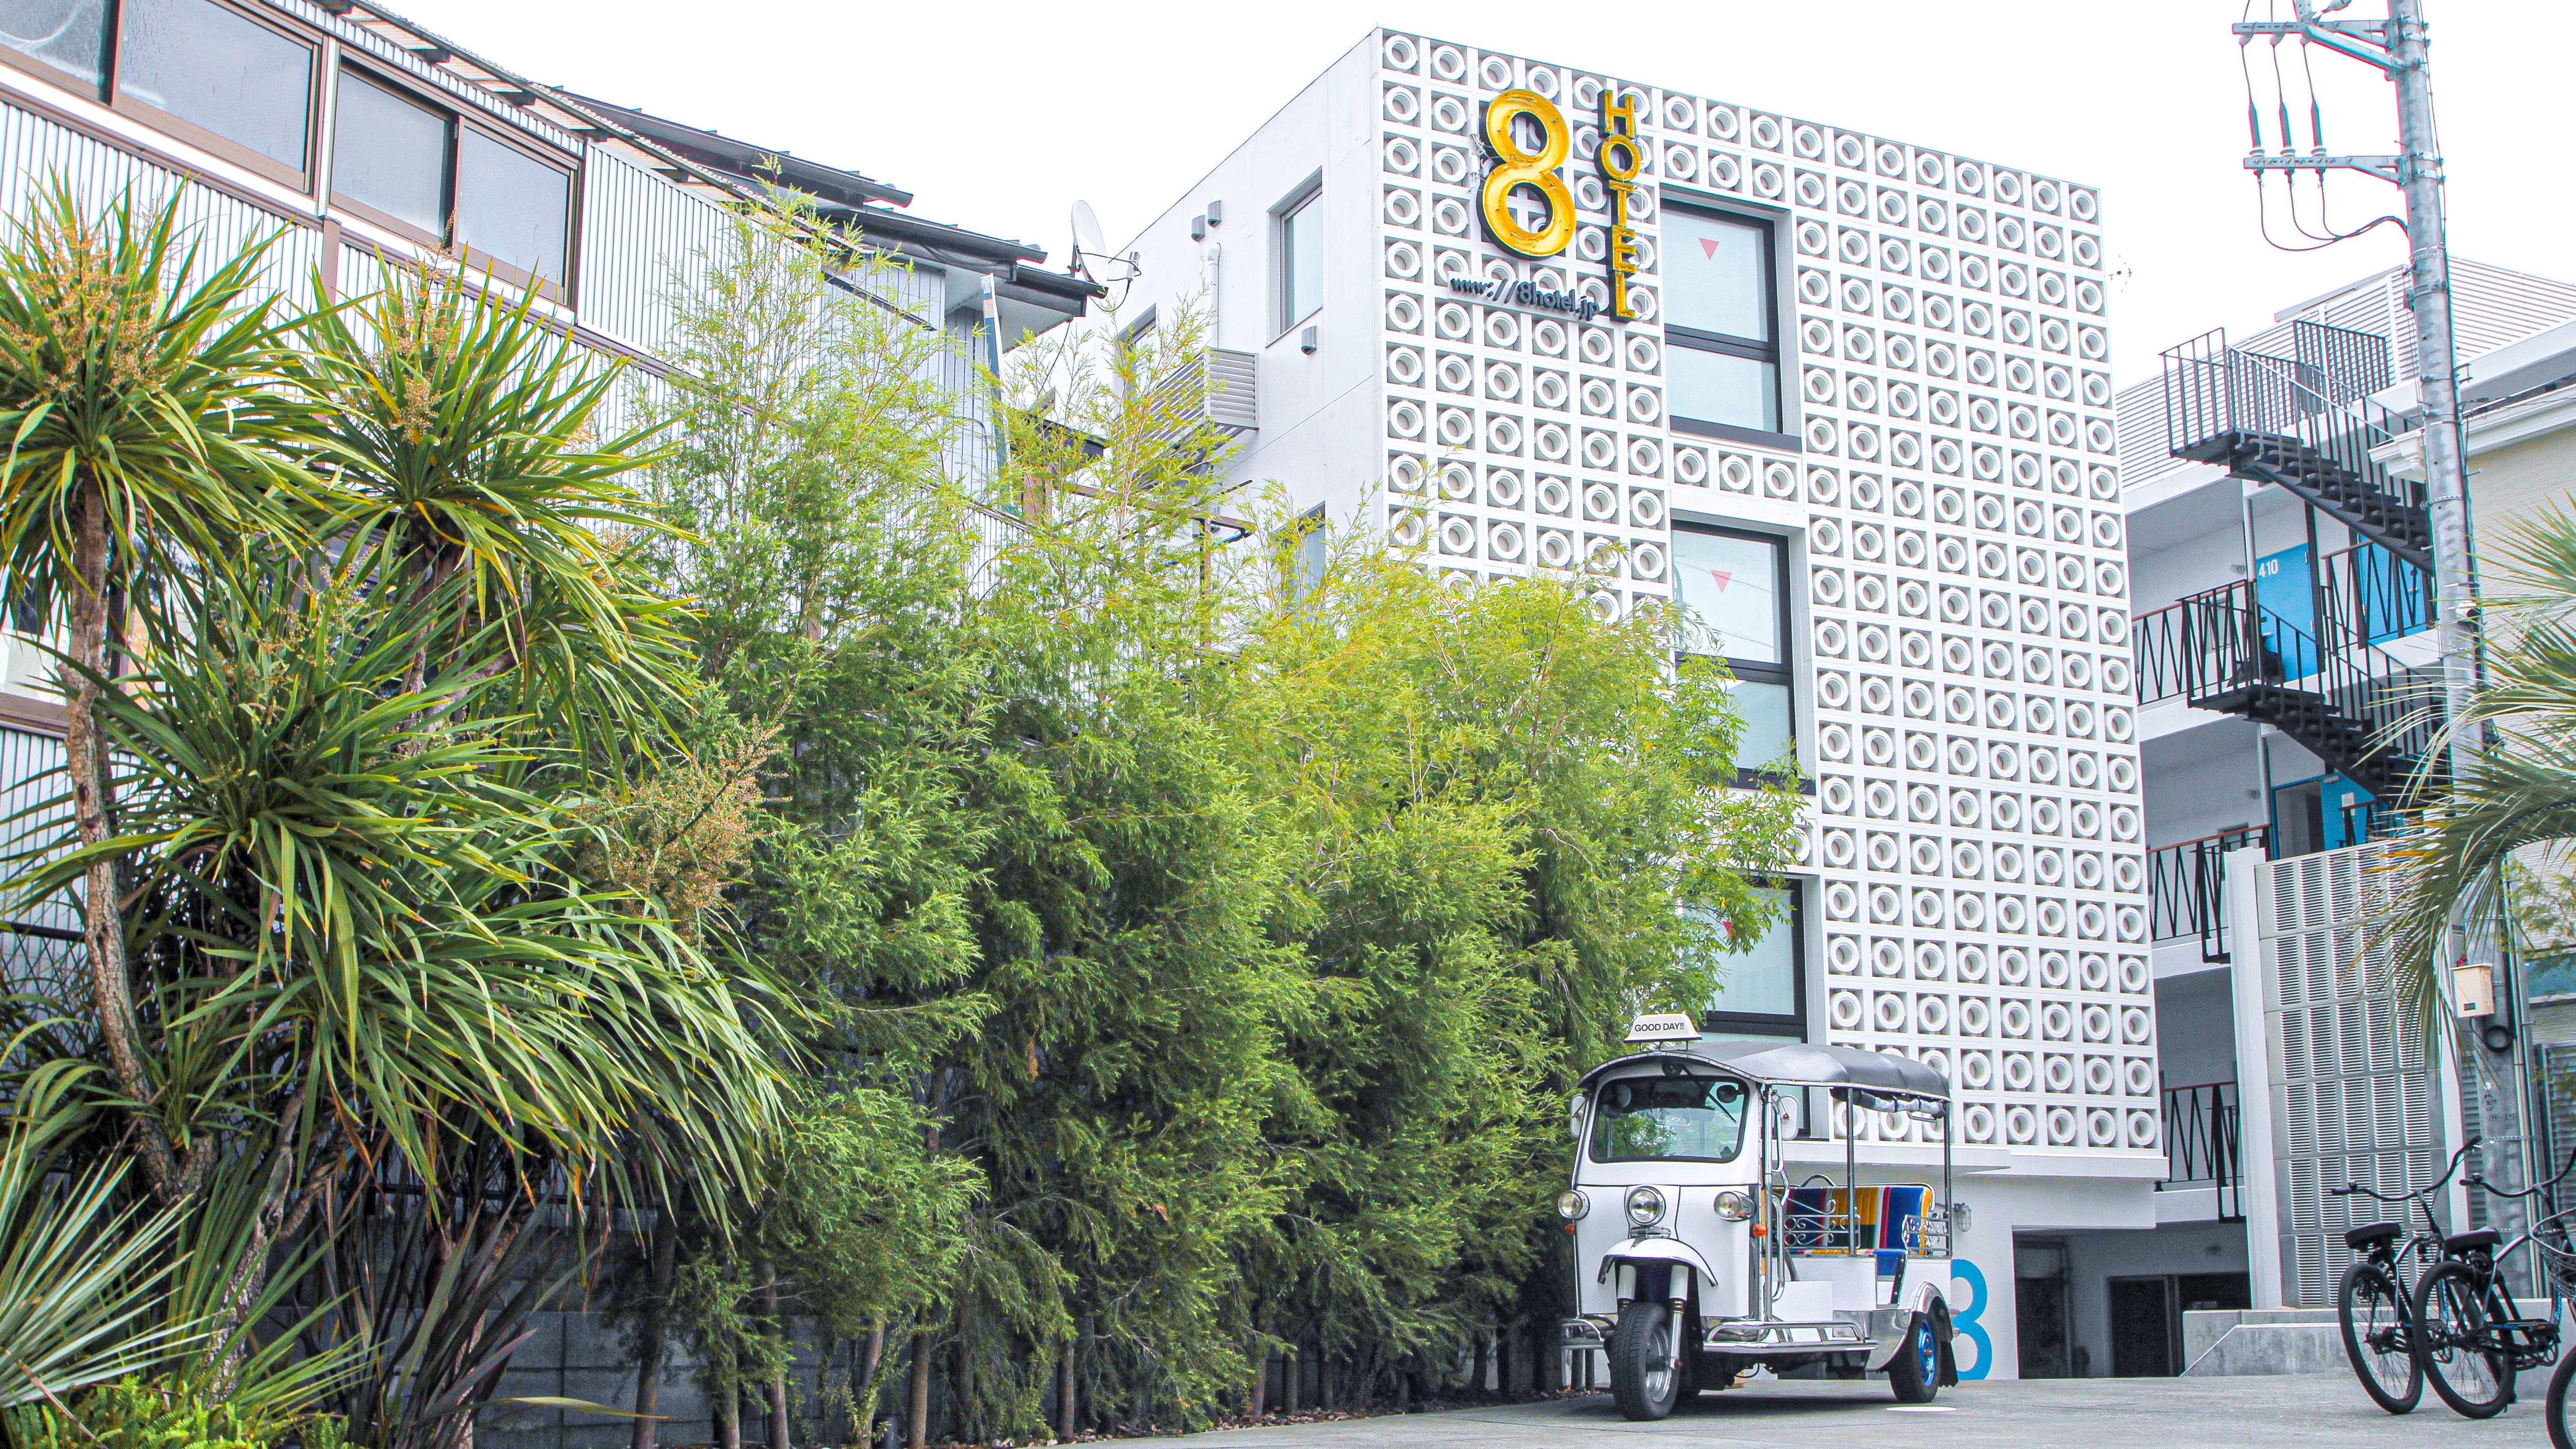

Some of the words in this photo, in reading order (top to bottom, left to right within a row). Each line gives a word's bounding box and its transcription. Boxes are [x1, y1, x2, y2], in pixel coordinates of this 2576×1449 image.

[1478, 89, 1576, 259] 8
[1595, 89, 1641, 322] HOTEL
[2259, 559, 2279, 577] 410
[1635, 1023, 1661, 1032] GOOD
